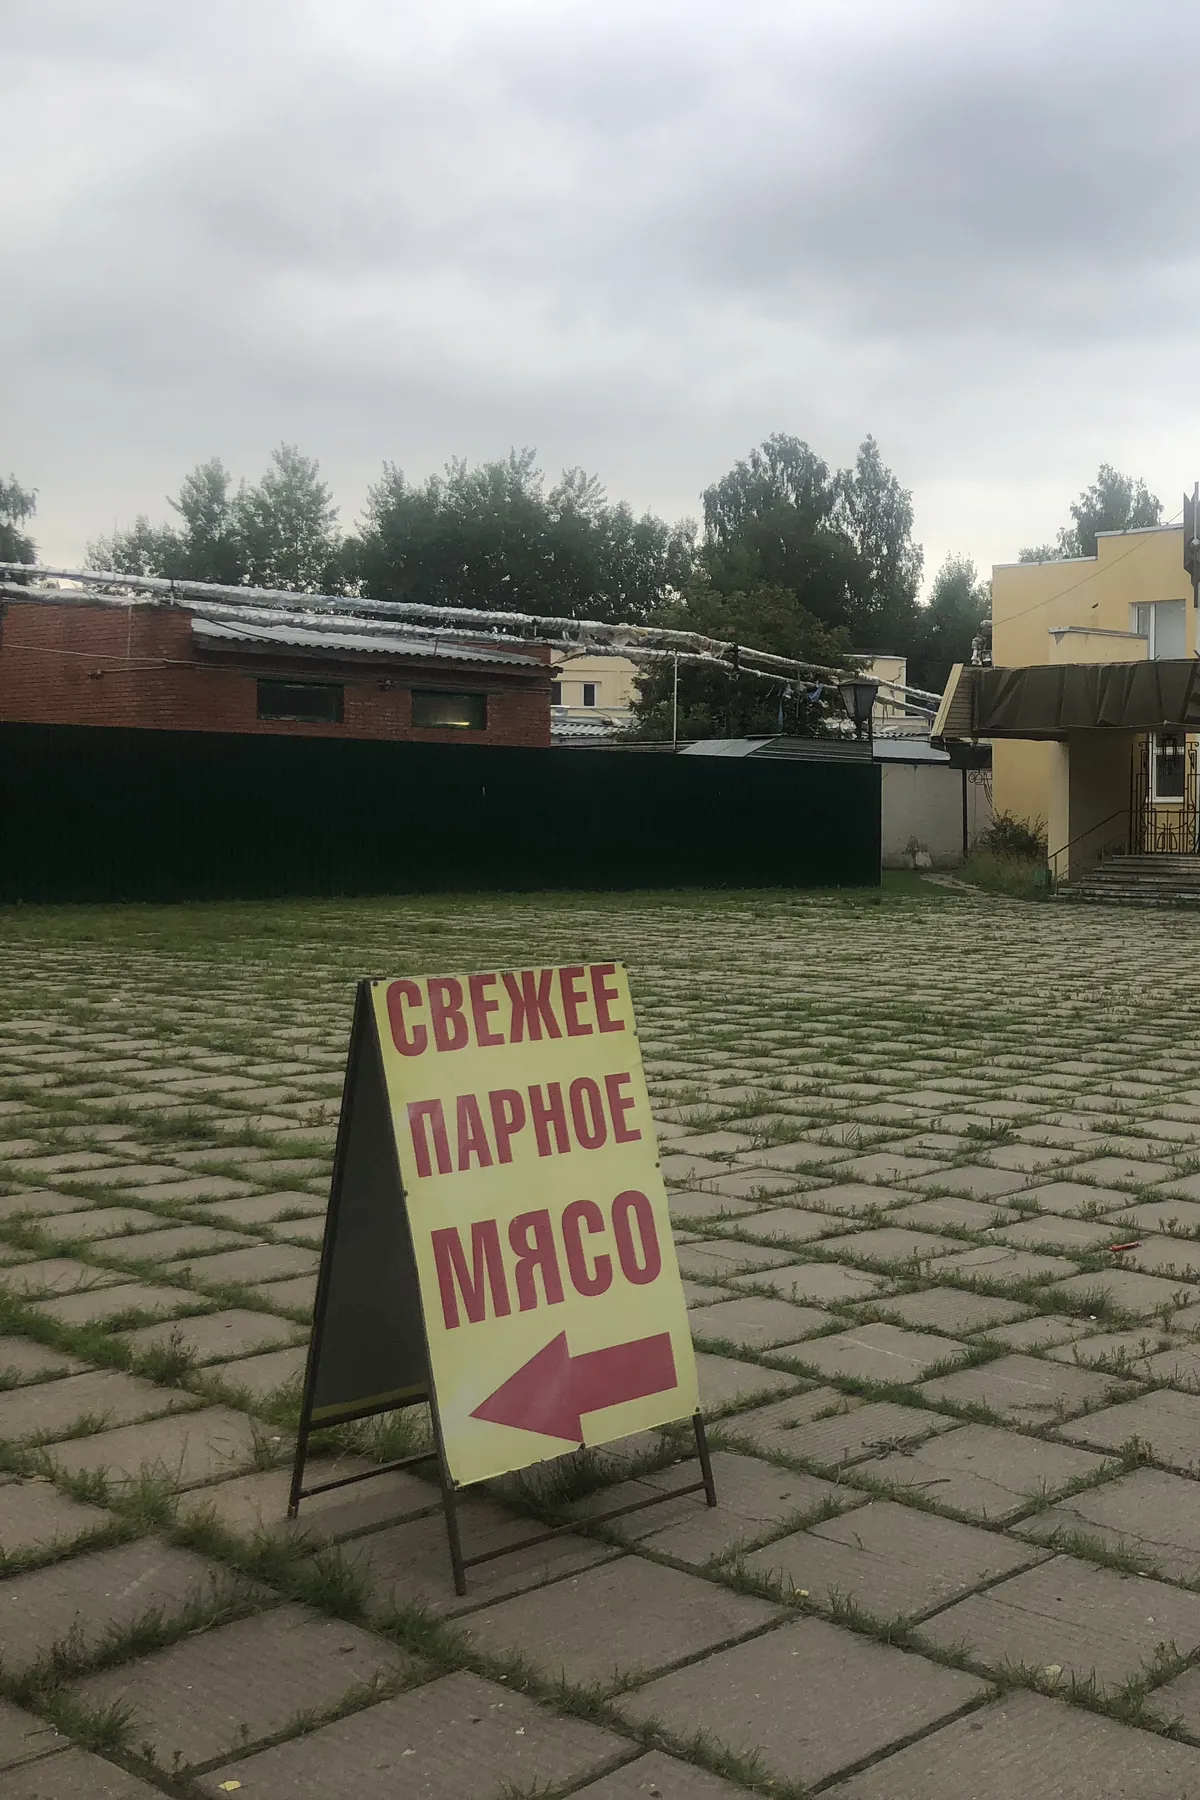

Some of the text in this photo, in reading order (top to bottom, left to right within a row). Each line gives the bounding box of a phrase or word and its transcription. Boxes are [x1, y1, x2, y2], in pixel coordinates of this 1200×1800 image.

[386, 964, 625, 1057] СВЕЖЕЕ
[407, 1072, 642, 1178] ПАРНОЕ
[430, 1190, 663, 1330] МЯСО
